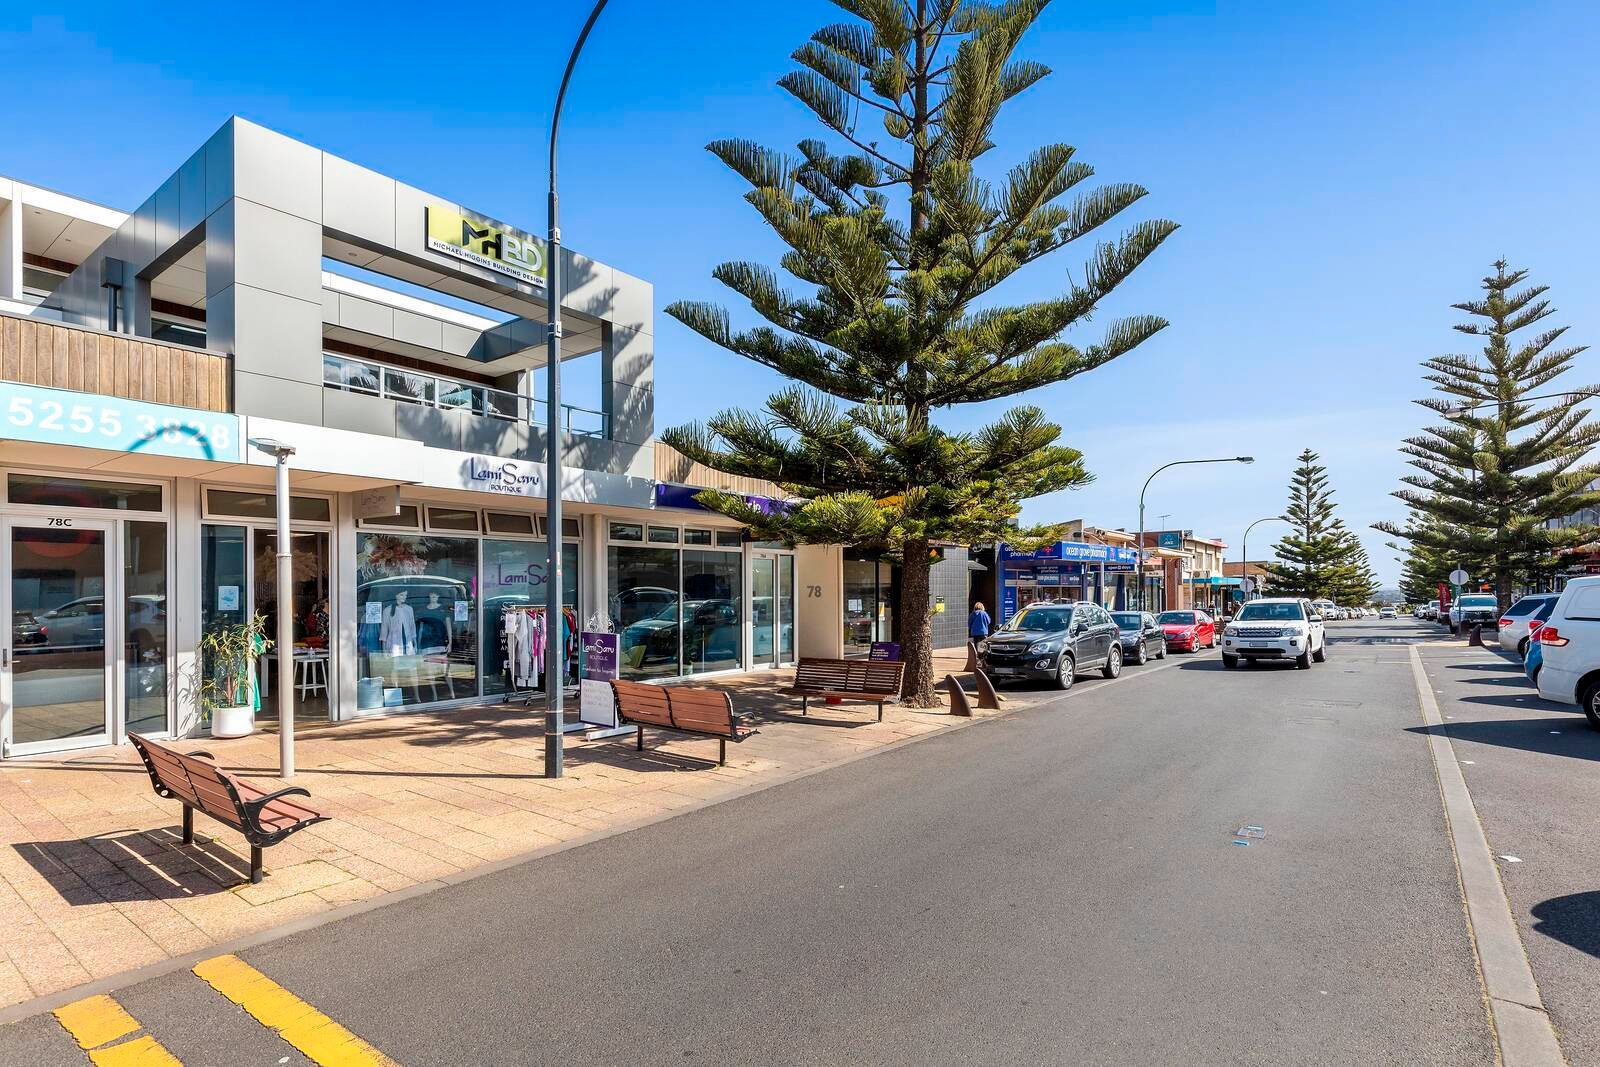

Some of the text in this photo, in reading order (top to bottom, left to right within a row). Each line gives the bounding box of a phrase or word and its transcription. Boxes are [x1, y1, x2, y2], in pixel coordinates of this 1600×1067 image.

[433, 241, 544, 285] MICHAEL HIGGINS BUILDING DESIGN
[7, 396, 230, 449] 5255 3828
[490, 483, 522, 493] BOUTIQUE
[47, 517, 72, 527] 78C
[806, 585, 822, 598] 78
